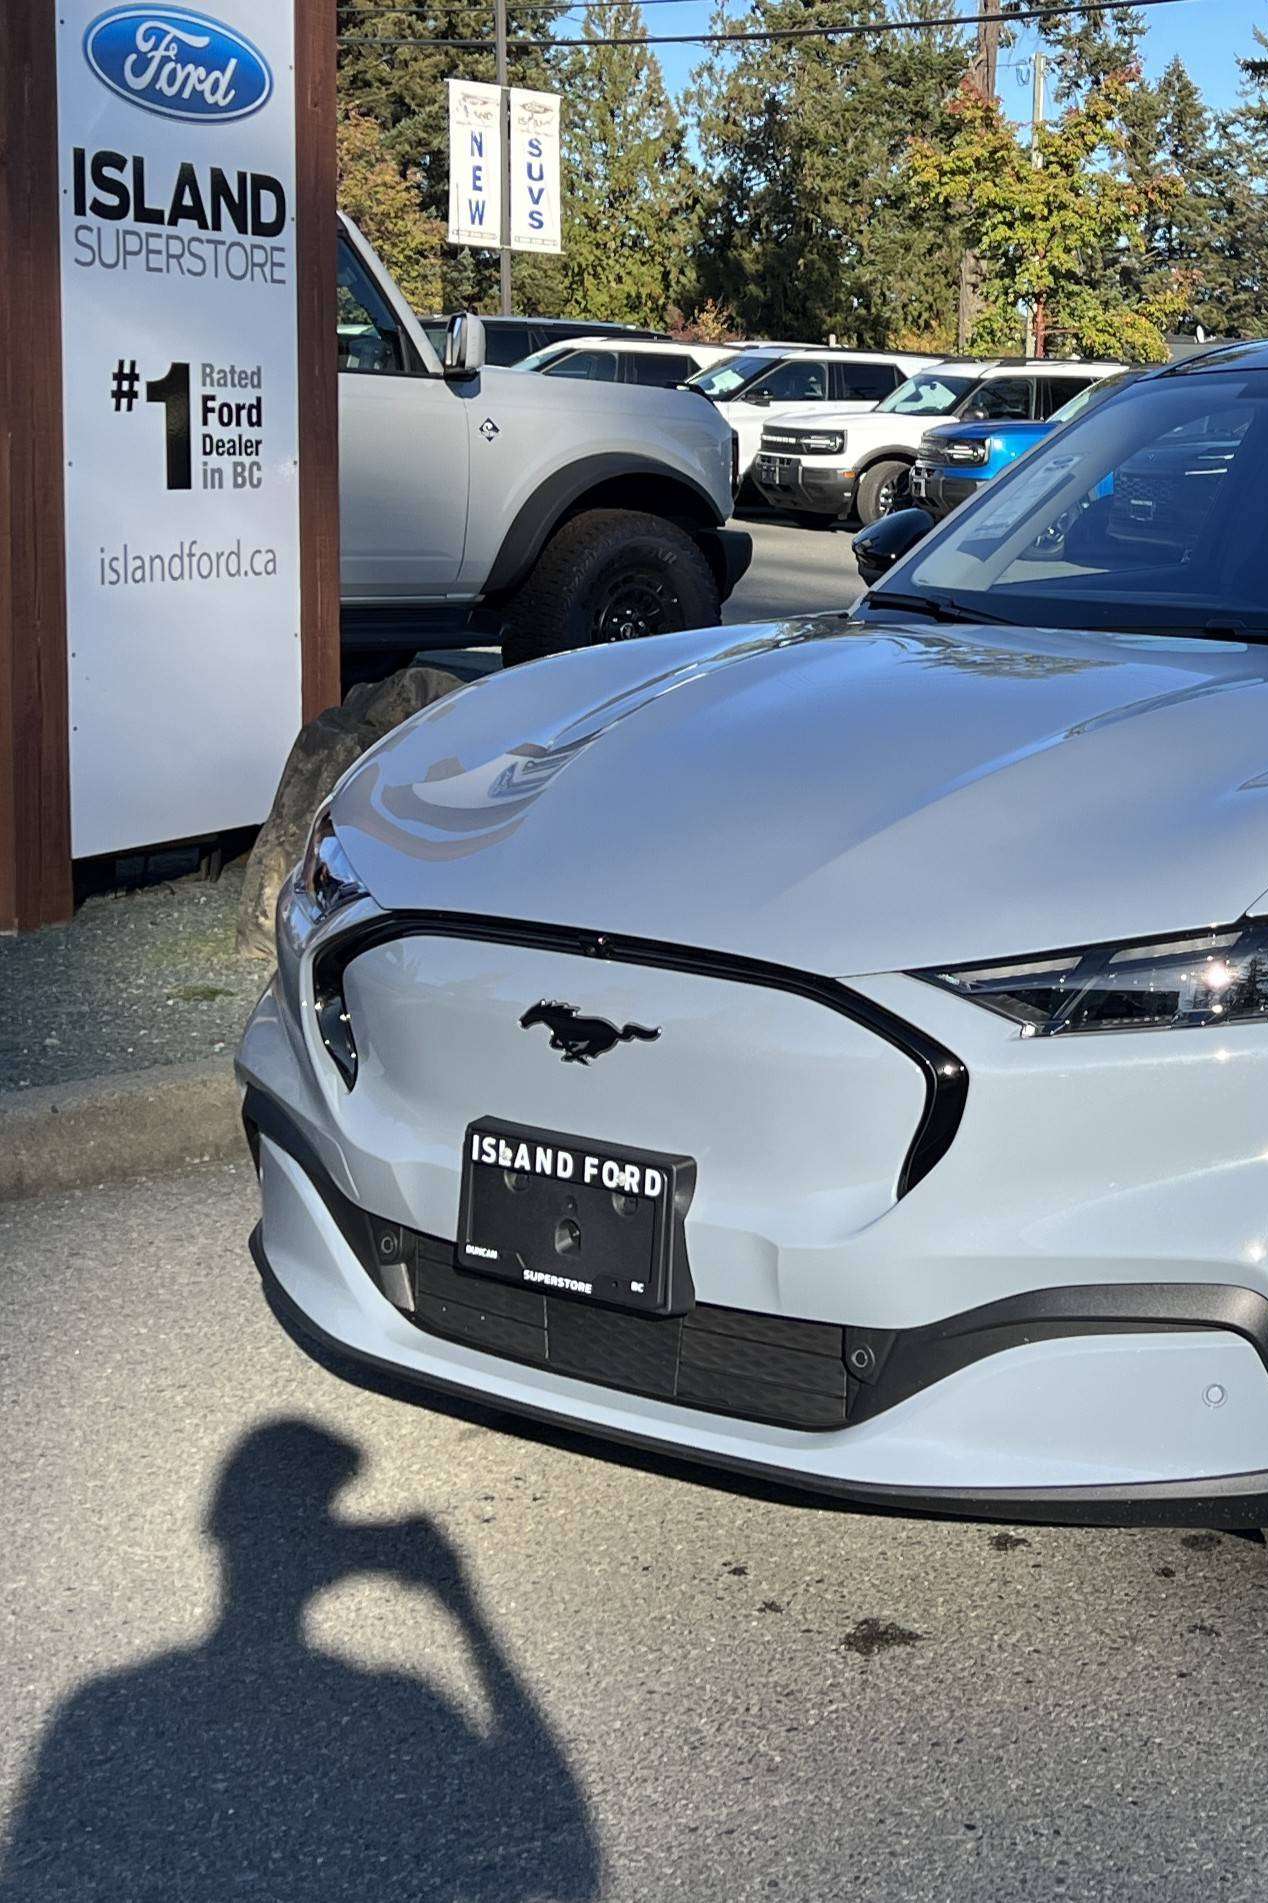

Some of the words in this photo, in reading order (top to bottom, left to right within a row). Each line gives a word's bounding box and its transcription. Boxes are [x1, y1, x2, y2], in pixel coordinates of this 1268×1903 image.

[124, 20, 238, 107] Ford
[73, 147, 286, 238] ISLAND
[468, 130, 486, 226] NEW
[526, 137, 545, 230] SUVS
[74, 224, 286, 285] SUPERSTORE
[201, 363, 262, 389] Rated
[111, 359, 192, 490] #1
[201, 394, 262, 427] Ford
[202, 433, 262, 457] Dealer
[202, 461, 223, 489] in
[232, 461, 262, 489] BC
[100, 539, 277, 586] islandford.ca
[471, 1134, 574, 1179] ISLAND
[583, 1156, 662, 1197] FORD
[523, 1269, 593, 1294] SUPERSTORE
